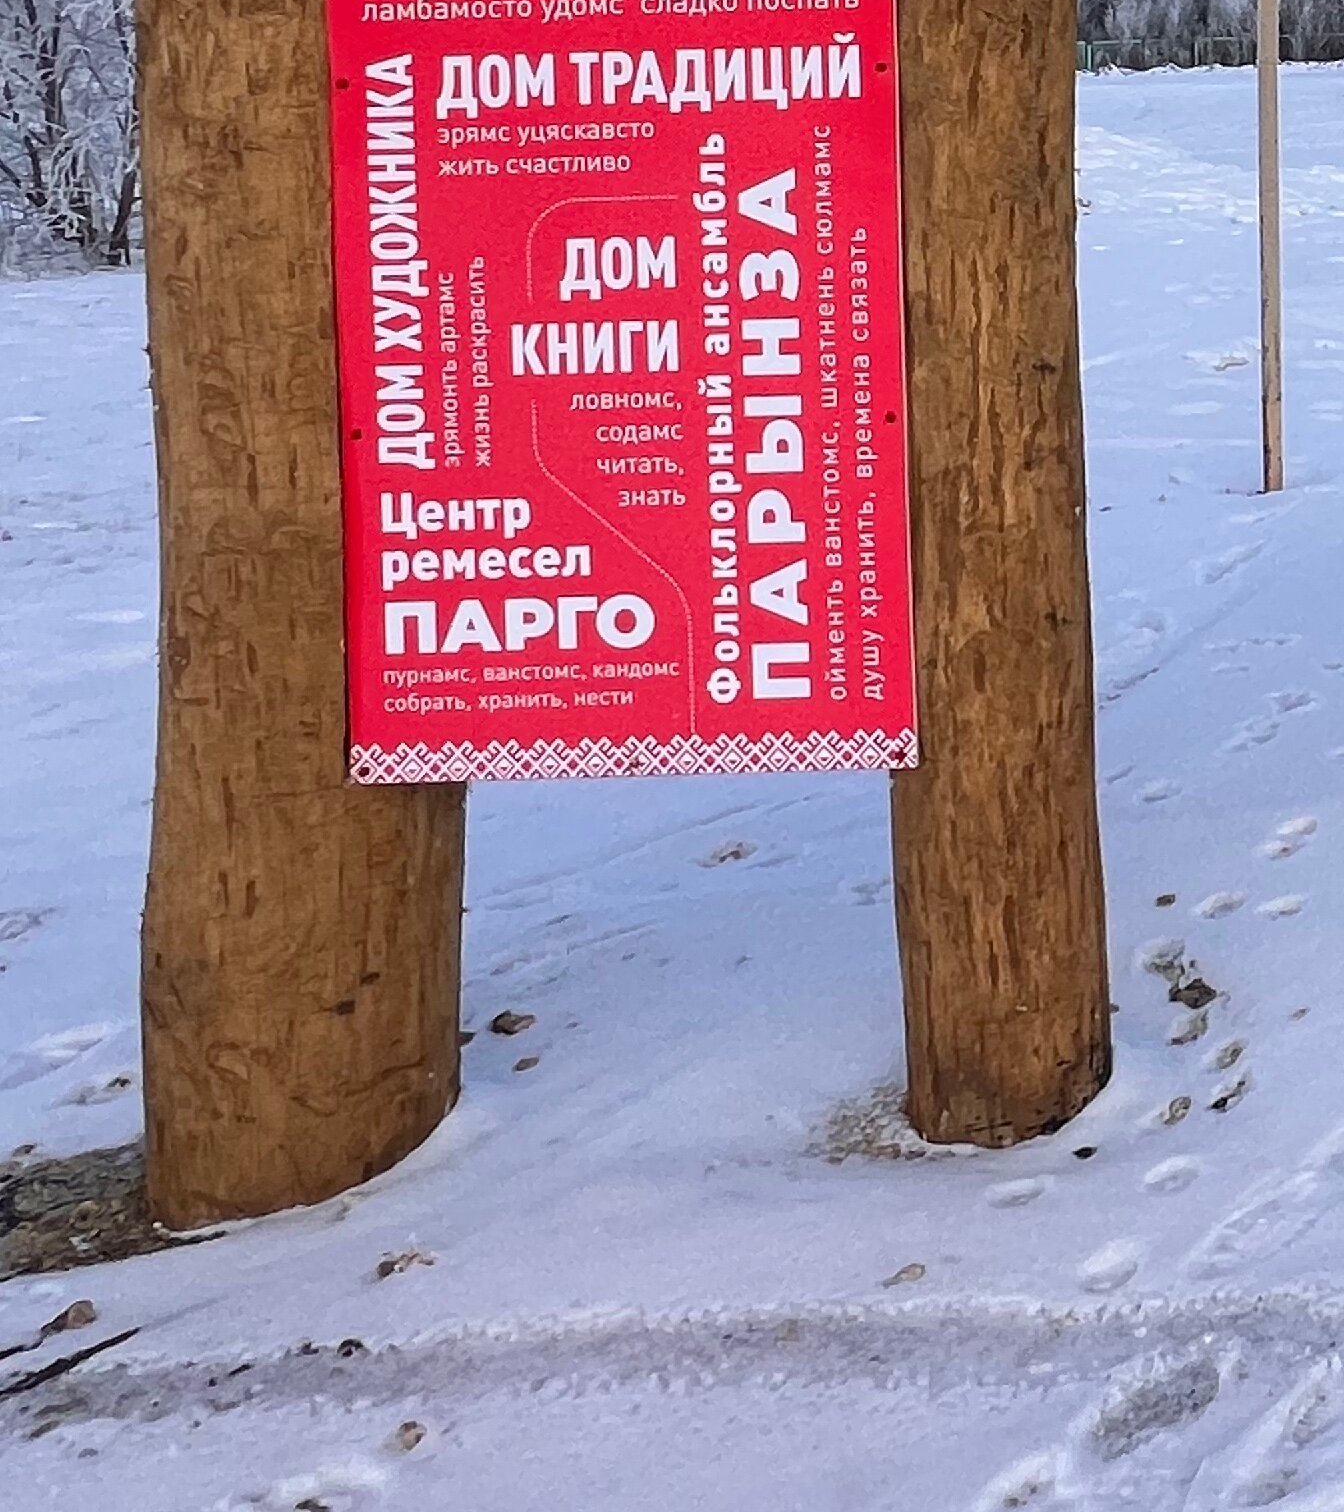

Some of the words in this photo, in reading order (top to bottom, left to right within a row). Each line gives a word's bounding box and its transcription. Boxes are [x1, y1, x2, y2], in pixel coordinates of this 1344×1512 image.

[437, 53, 554, 119] ДОМ
[569, 33, 860, 113] ТРАДИЦИЙ
[437, 126, 511, 149] эрямс
[517, 122, 654, 146] уцяскавсто
[439, 159, 499, 176] жить
[506, 155, 630, 173] счастливо
[365, 54, 429, 352] ХУДОЖНИКА
[814, 126, 833, 254] сюлмамс
[560, 236, 675, 301] ДОМ
[693, 134, 729, 355] ансамбль
[439, 273, 461, 352] артамс
[469, 257, 494, 387] раскрасить
[851, 228, 869, 341] связать
[511, 320, 678, 375] КНИГИ
[818, 267, 837, 407] шкатнень
[375, 365, 435, 469] ДОМ
[442, 360, 465, 467] эрямонть
[474, 395, 490, 466] жизнь
[570, 392, 681, 410] ловномс,
[596, 424, 683, 445] содамс
[738, 168, 811, 699] ПАРЫНЗА
[854, 355, 877, 477] времена
[597, 457, 683, 475] читать,
[619, 489, 685, 506] знать
[822, 422, 842, 566] ванстомс,
[381, 493, 530, 539] Центр
[698, 375, 742, 703] Фольклорный
[858, 493, 882, 617] хранить,
[382, 545, 590, 590] ремесел
[385, 595, 655, 654] ПАРГО
[825, 580, 847, 700] ойменть
[384, 669, 476, 688] пурнамс,
[483, 665, 586, 681] ванстомс,
[593, 663, 679, 679] кандомс
[384, 693, 471, 715] собрать,
[479, 693, 567, 713] хранить,
[574, 691, 633, 705] нести
[862, 630, 885, 700] душу
